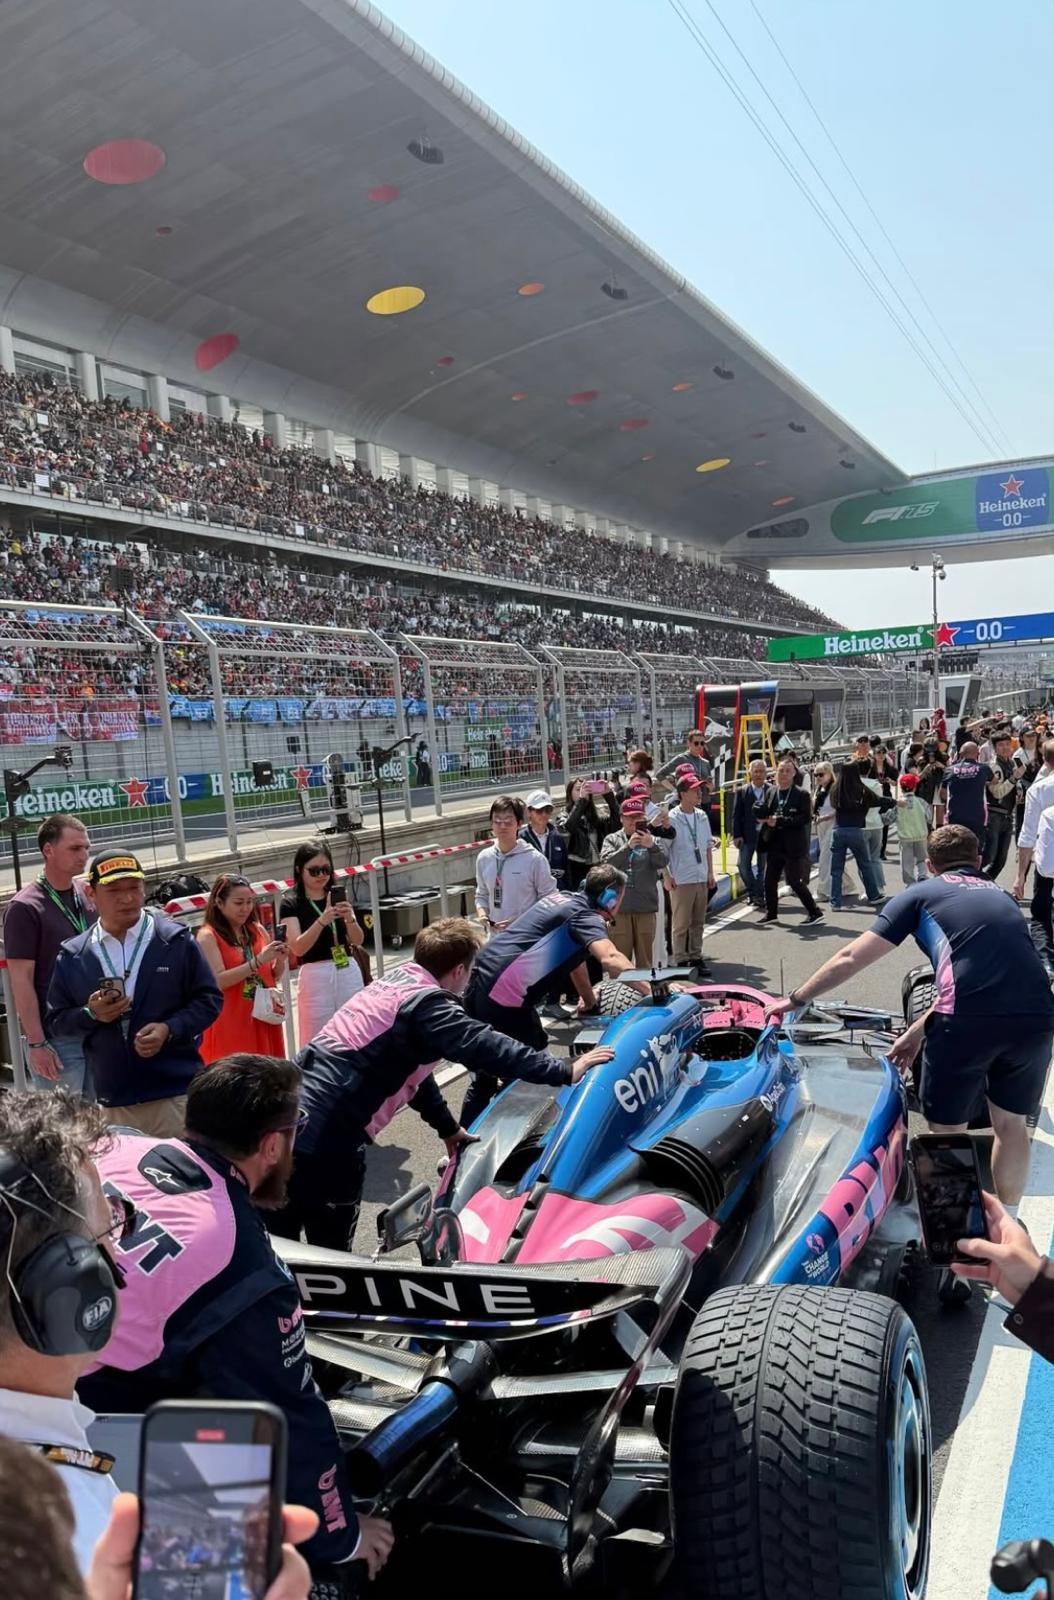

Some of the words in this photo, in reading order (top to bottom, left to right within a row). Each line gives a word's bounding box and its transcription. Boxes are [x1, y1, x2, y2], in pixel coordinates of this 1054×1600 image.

[979, 497, 1046, 514] Heineken
[824, 631, 922, 655] Heineken
[976, 621, 1002, 640] 0.0
[614, 1049, 661, 1113] eni
[296, 1272, 536, 1313] PINE
[86, 1301, 109, 1326] FIA
